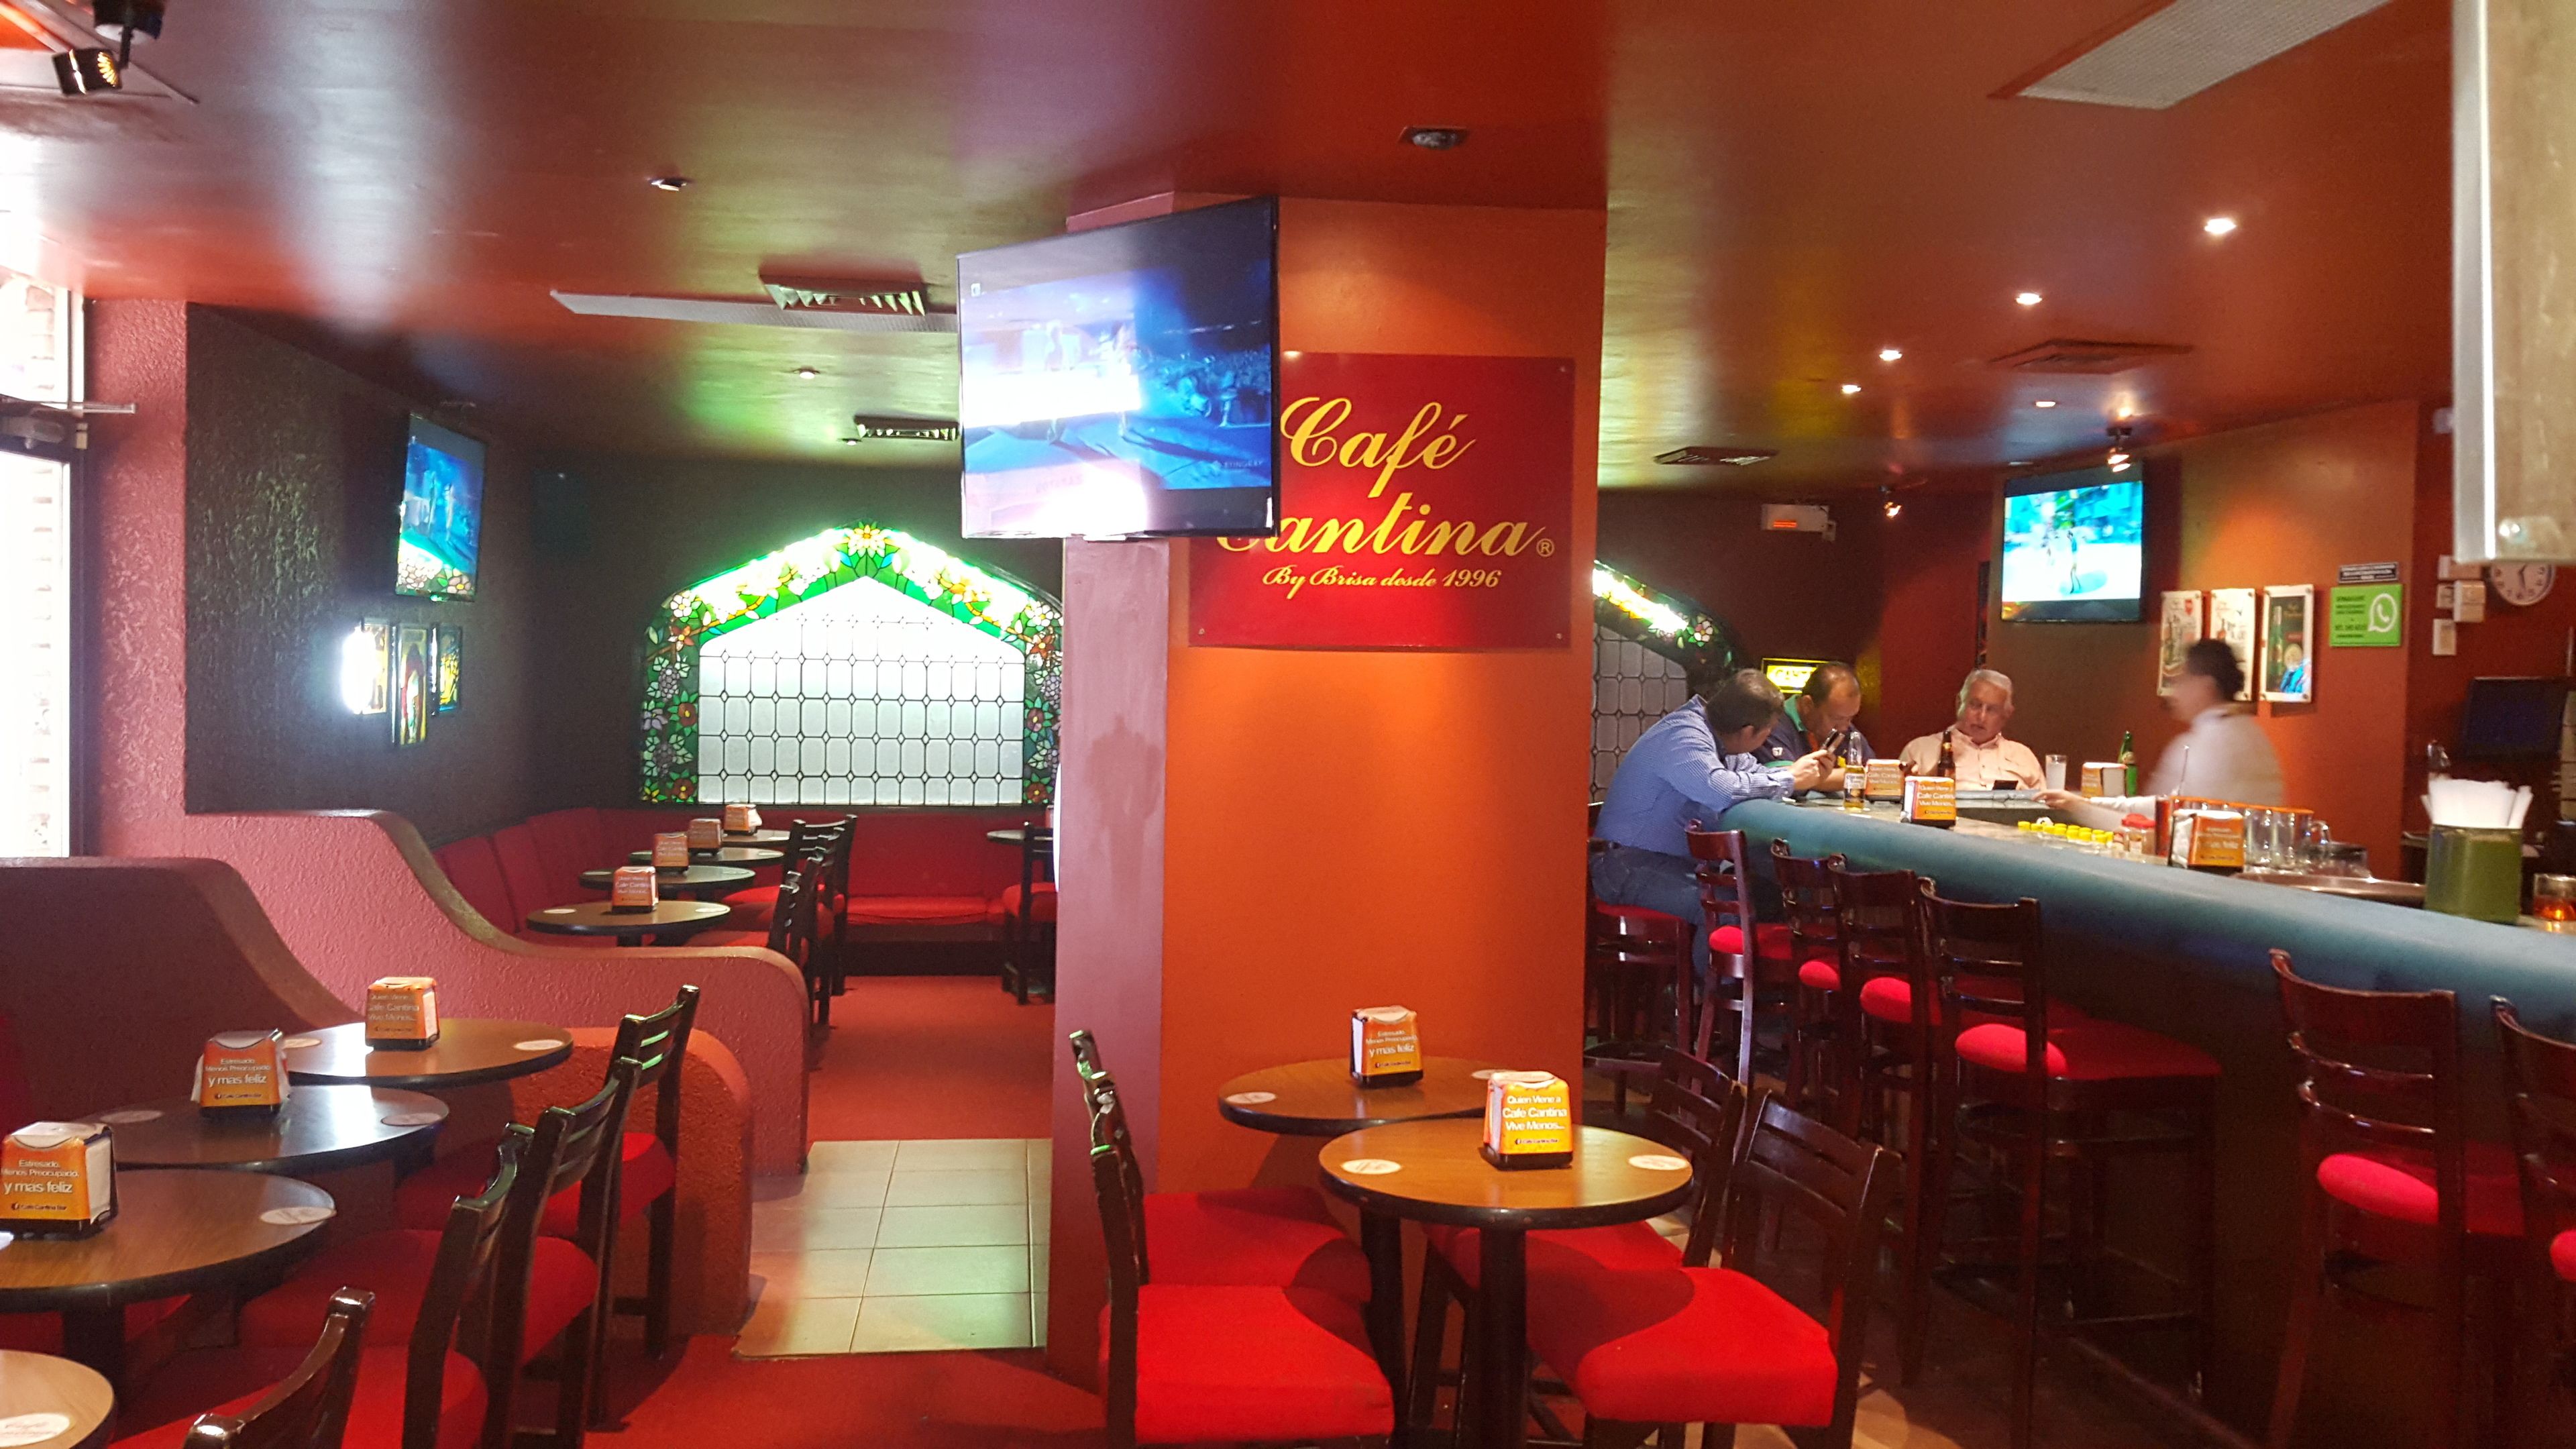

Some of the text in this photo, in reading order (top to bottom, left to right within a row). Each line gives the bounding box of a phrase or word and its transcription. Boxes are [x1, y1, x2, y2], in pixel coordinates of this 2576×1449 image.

[1280, 397, 1477, 497] Café
[1216, 492, 1546, 557] antina
[1263, 564, 1503, 599] By Brisa desde 1996
[208, 1077, 215, 1088] y
[244, 1073, 267, 1084] feliz
[1527, 1107, 1568, 1118] Cantina
[1505, 1120, 1525, 1131] Vive
[3, 1182, 13, 1195] y
[46, 1180, 73, 1193] feliz
